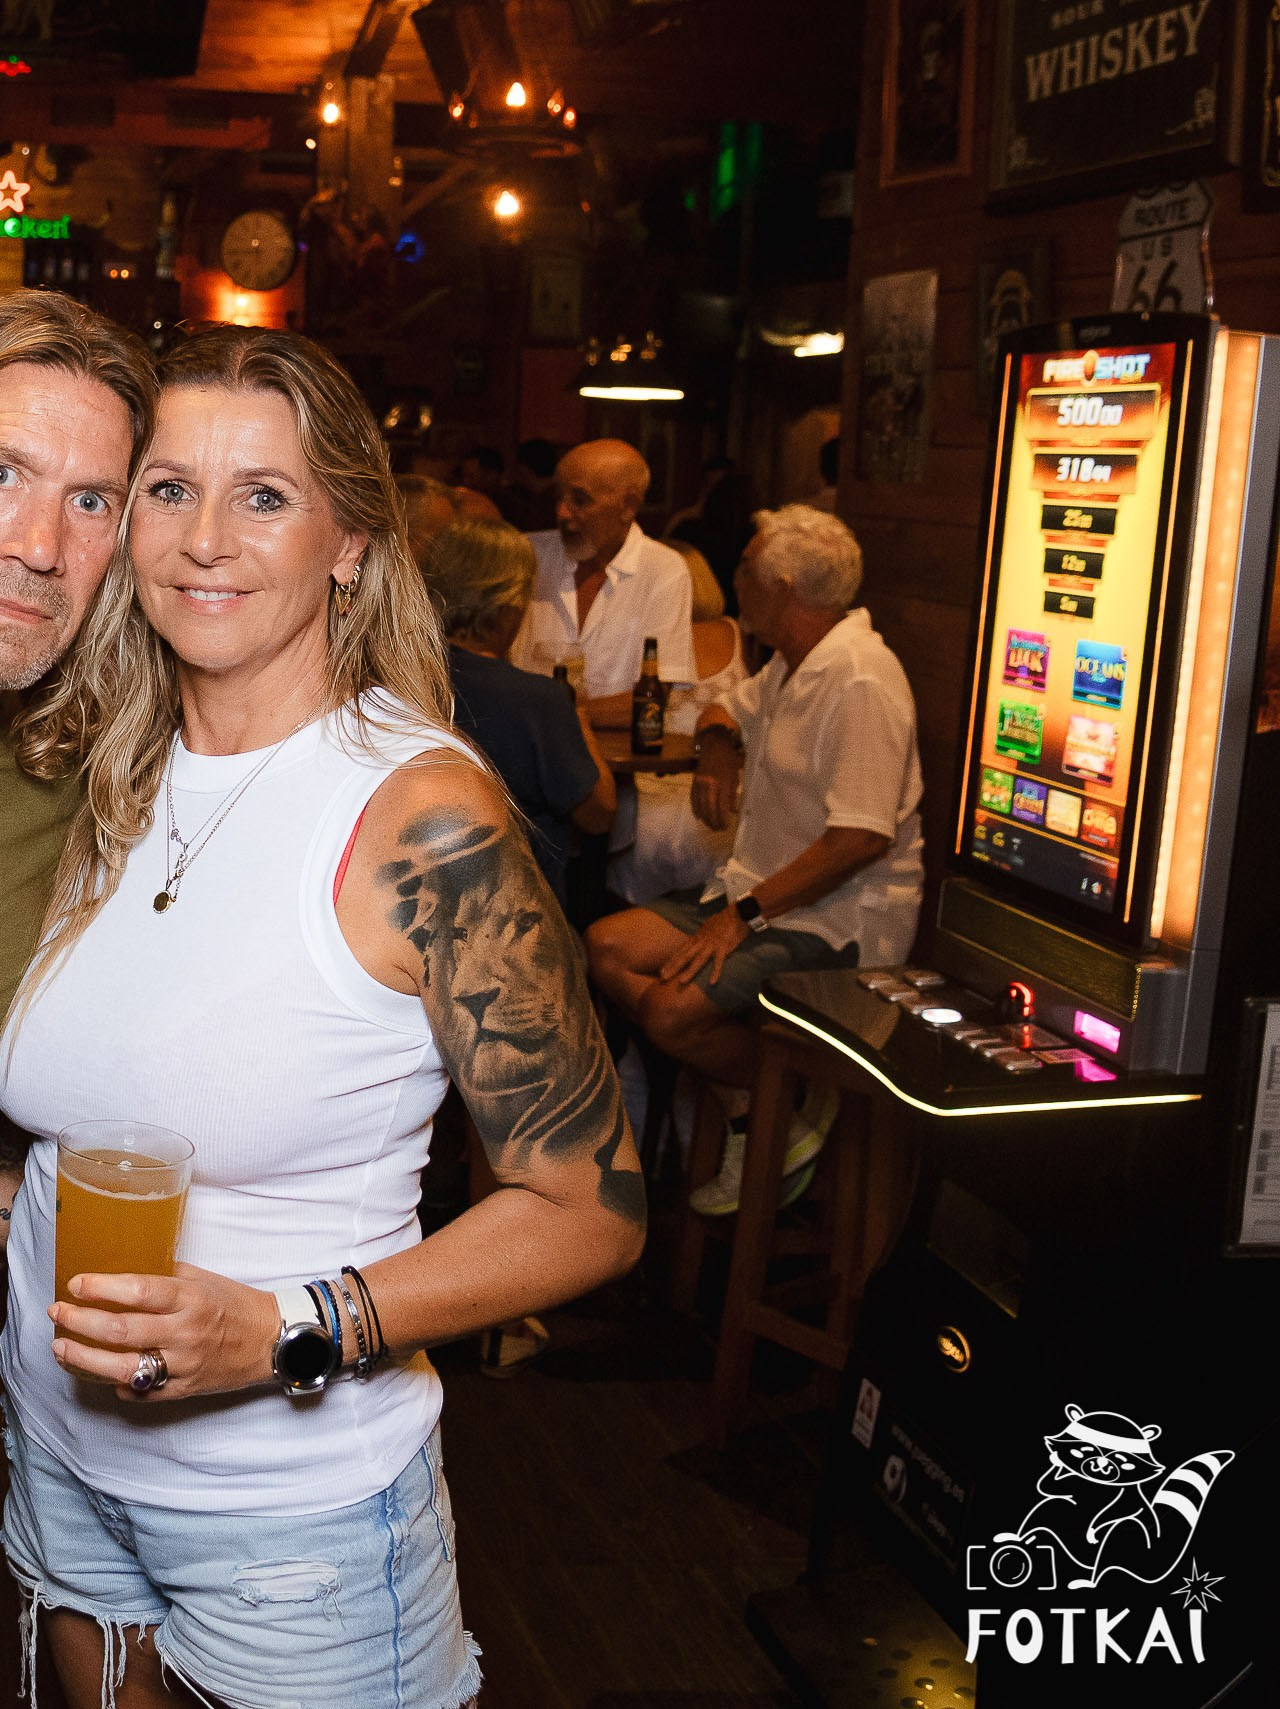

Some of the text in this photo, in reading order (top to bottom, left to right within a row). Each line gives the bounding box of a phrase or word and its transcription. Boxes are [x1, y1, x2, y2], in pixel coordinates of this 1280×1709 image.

[1025, 0, 1213, 103] WHISKEY
[1134, 198, 1193, 226] ROUTE
[1094, 353, 1151, 380] SHOT
